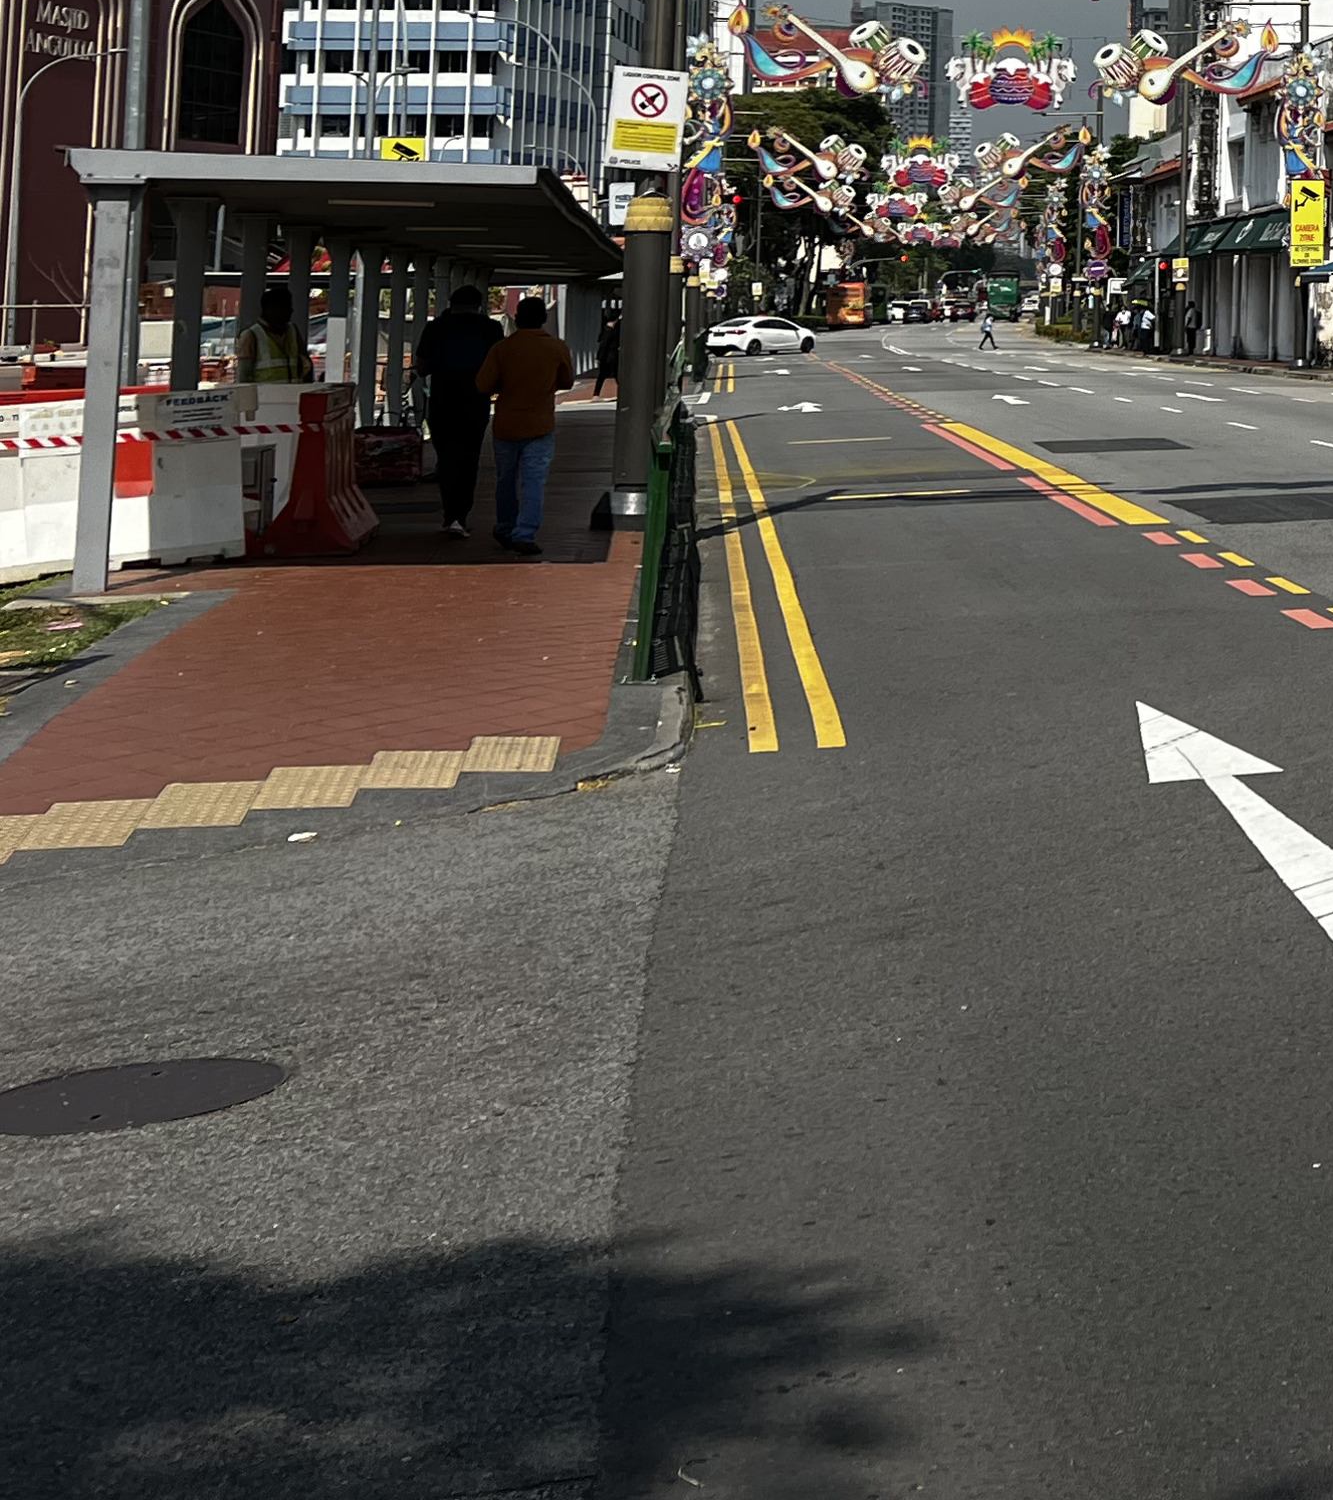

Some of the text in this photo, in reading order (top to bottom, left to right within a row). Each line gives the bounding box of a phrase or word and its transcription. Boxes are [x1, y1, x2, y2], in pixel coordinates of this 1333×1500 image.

[36, 0, 90, 34] MASJID
[1295, 224, 1320, 232] CAMERA
[1299, 234, 1315, 242] ZONE
[166, 393, 229, 407] FEEDBACK
